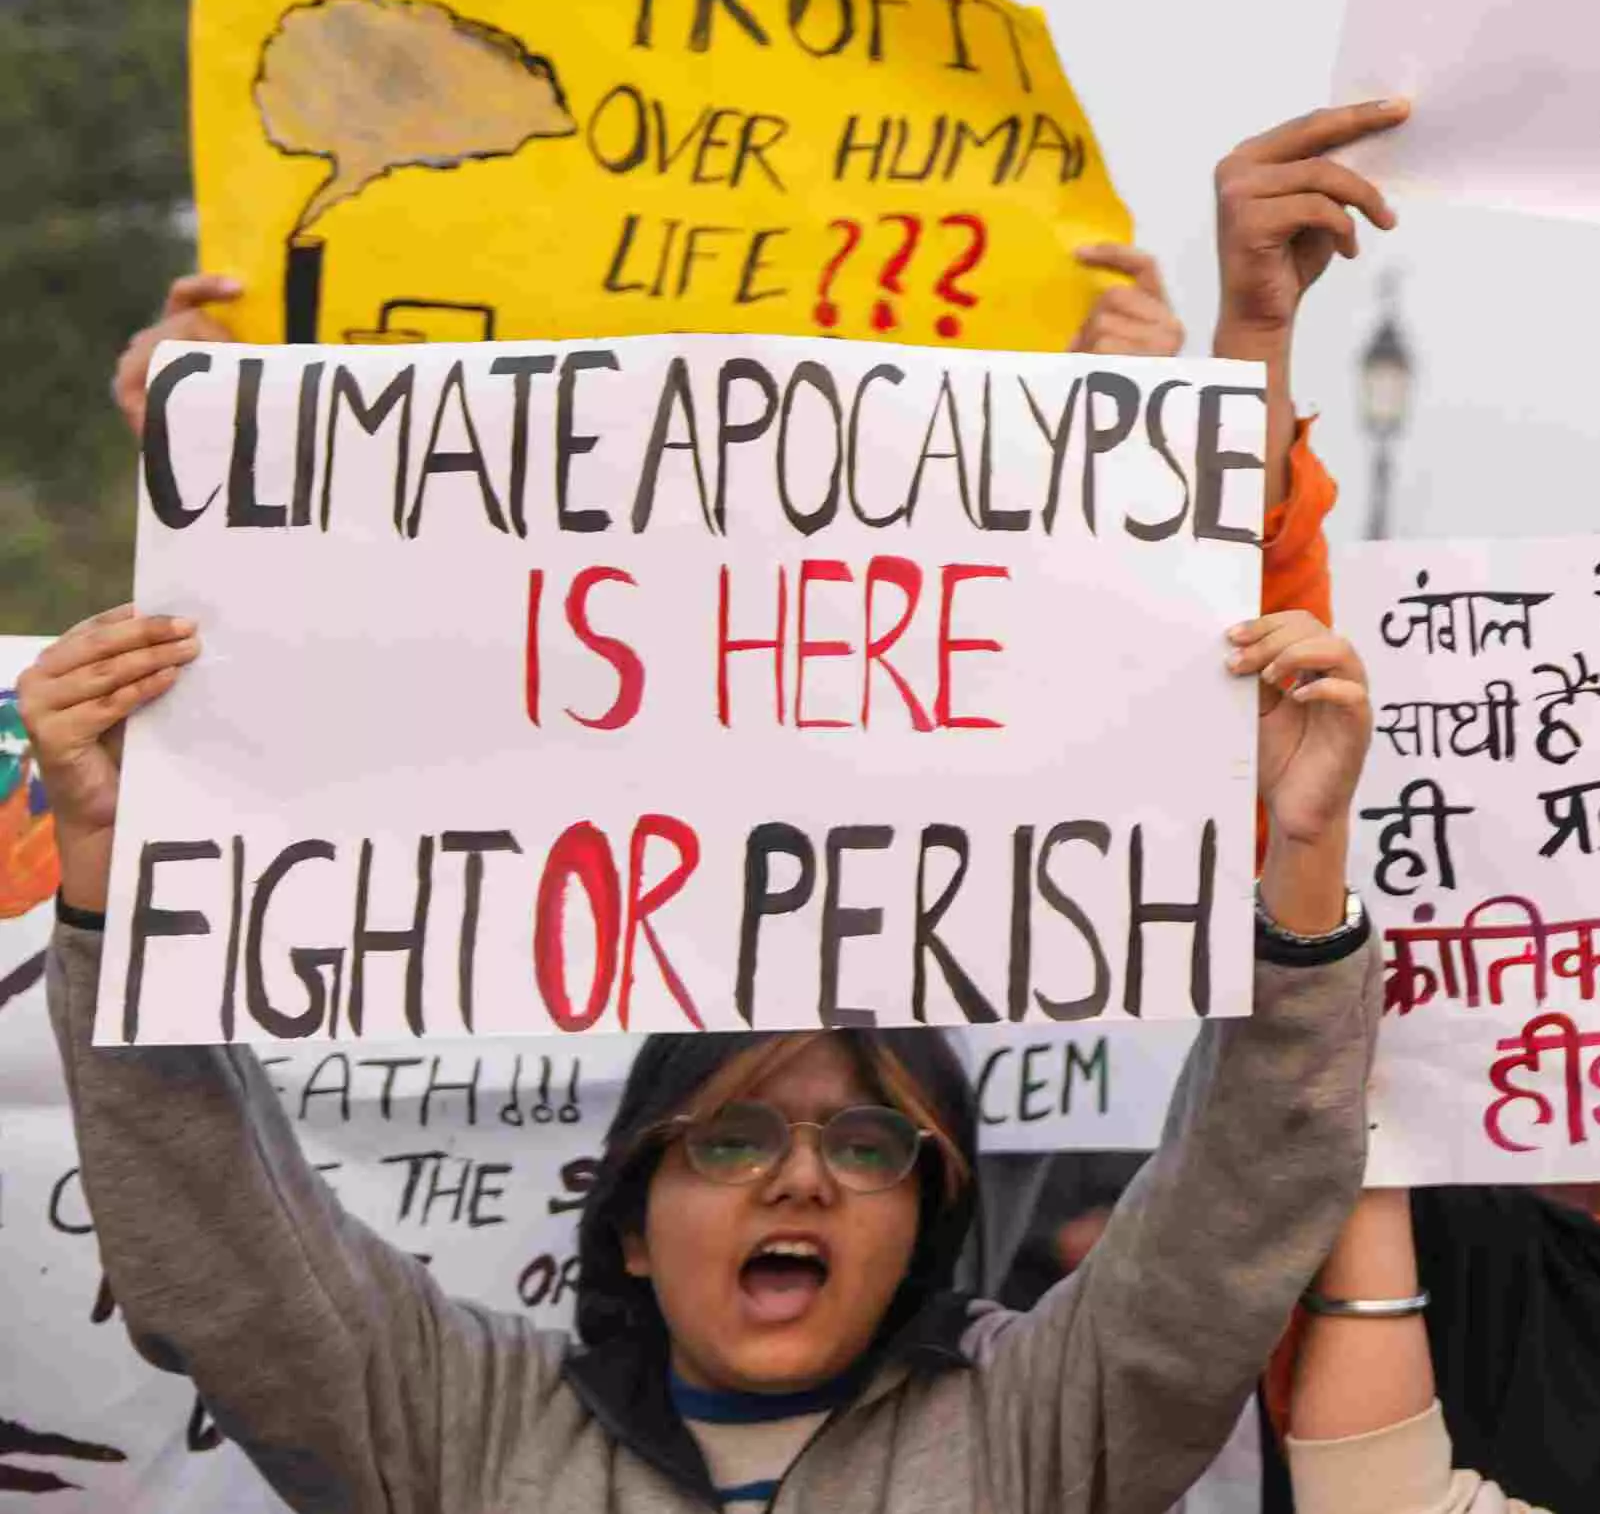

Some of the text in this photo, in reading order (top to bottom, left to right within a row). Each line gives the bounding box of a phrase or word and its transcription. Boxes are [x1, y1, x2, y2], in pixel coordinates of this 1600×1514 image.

[585, 82, 789, 193] OVER
[142, 349, 1267, 544] CLIMATE APOCALYPSE
[525, 556, 1010, 733] IS HERE
[1381, 570, 1554, 656] जंगल
[1376, 680, 1518, 762] साथी
[1360, 778, 1473, 896] ही
[120, 813, 1217, 1046] FIGHT OR PERISH
[265, 1053, 582, 1126] ATH!!!
[381, 1151, 512, 1226] THE
